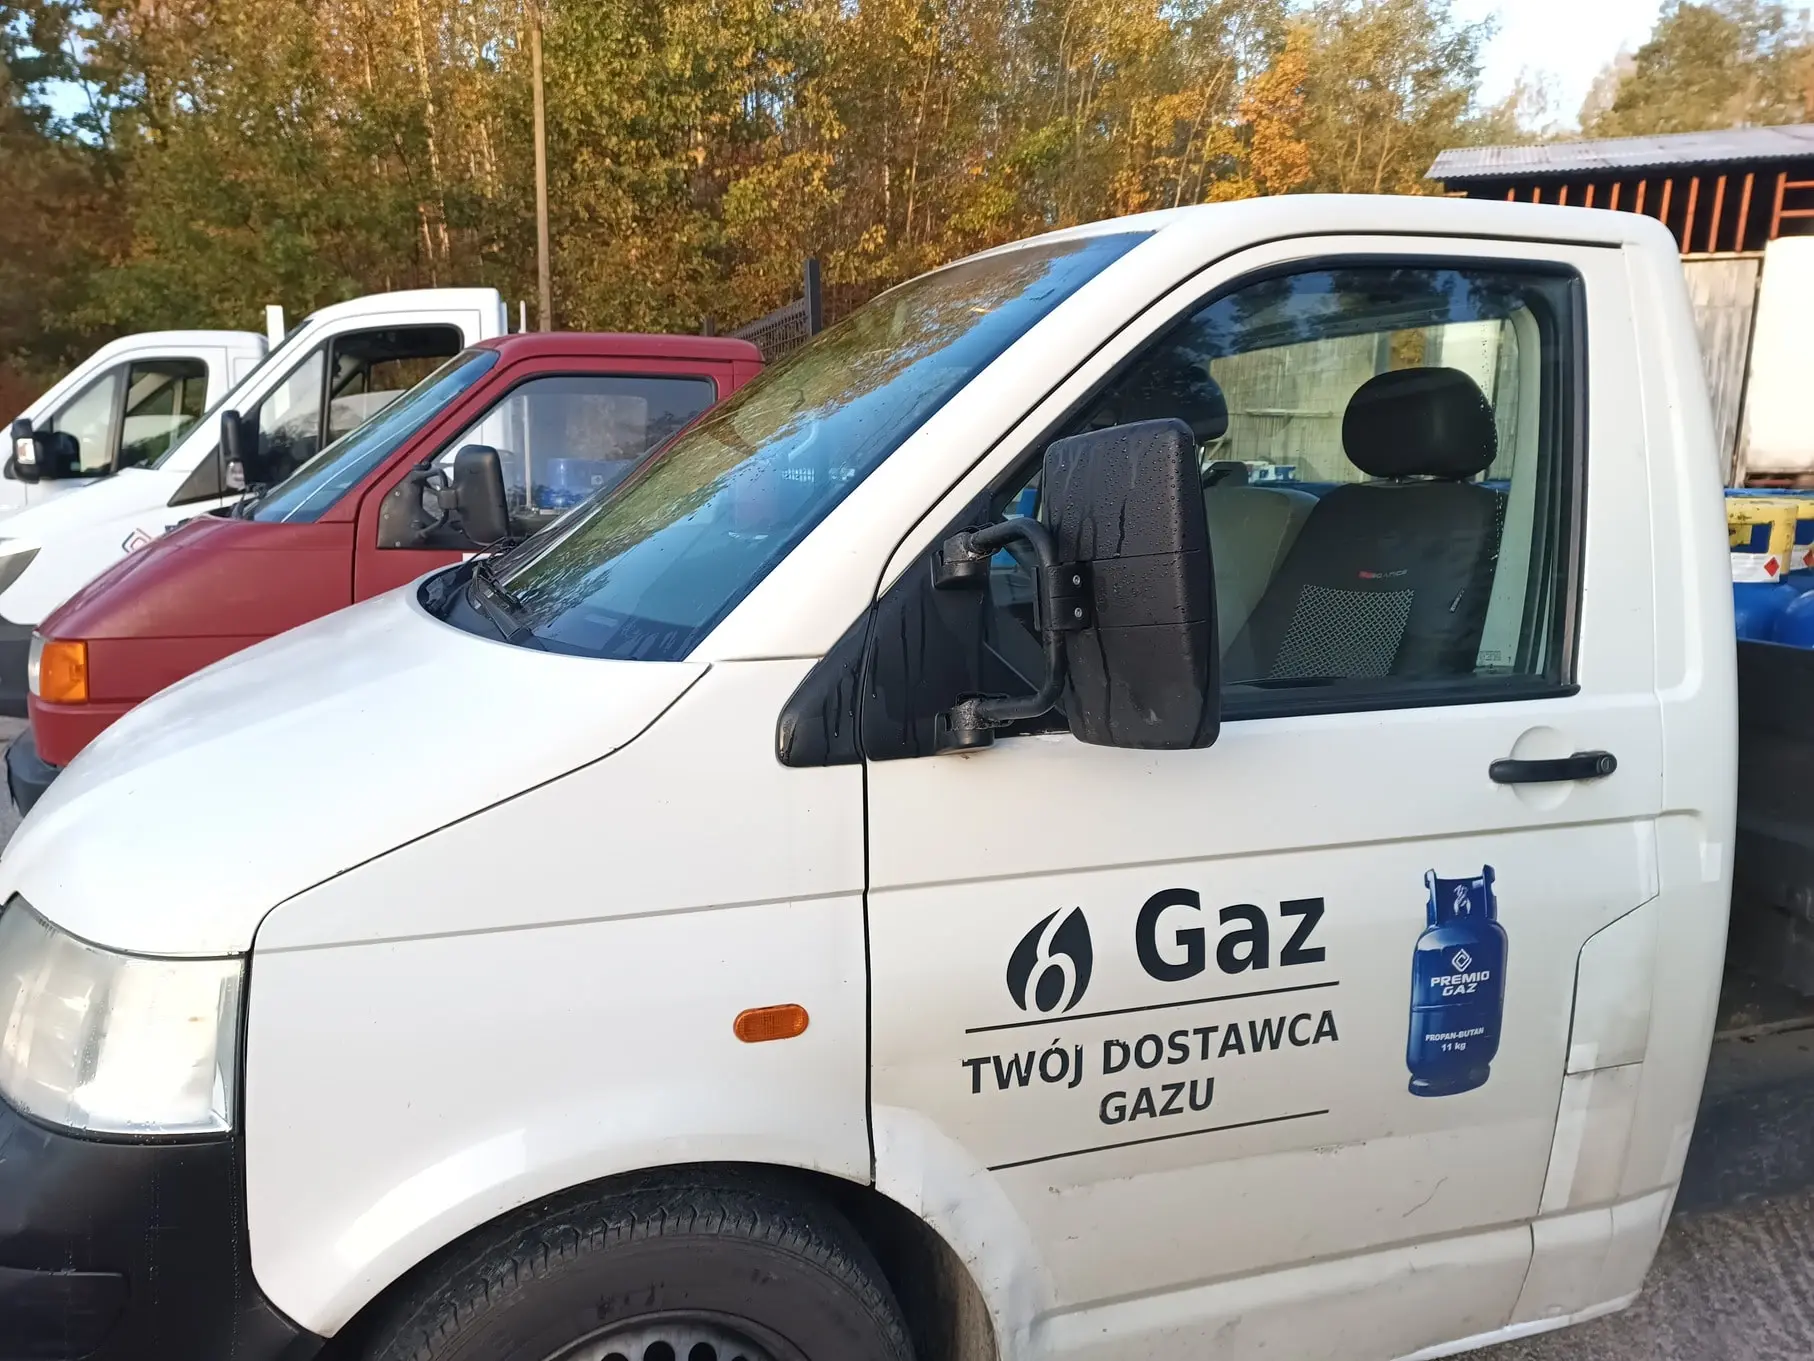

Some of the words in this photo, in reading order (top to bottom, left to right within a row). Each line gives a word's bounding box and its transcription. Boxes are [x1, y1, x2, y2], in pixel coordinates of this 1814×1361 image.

[1136, 888, 1326, 982] Gaz
[1431, 970, 1490, 987] PREMIO
[1442, 982, 1478, 996] GAZ
[962, 1037, 1084, 1094] TWÓJ
[1102, 1009, 1339, 1075] DOSTAWCA
[1441, 1043, 1452, 1052] 11
[1454, 1042, 1467, 1051] kg
[1099, 1077, 1215, 1125] GAZU
